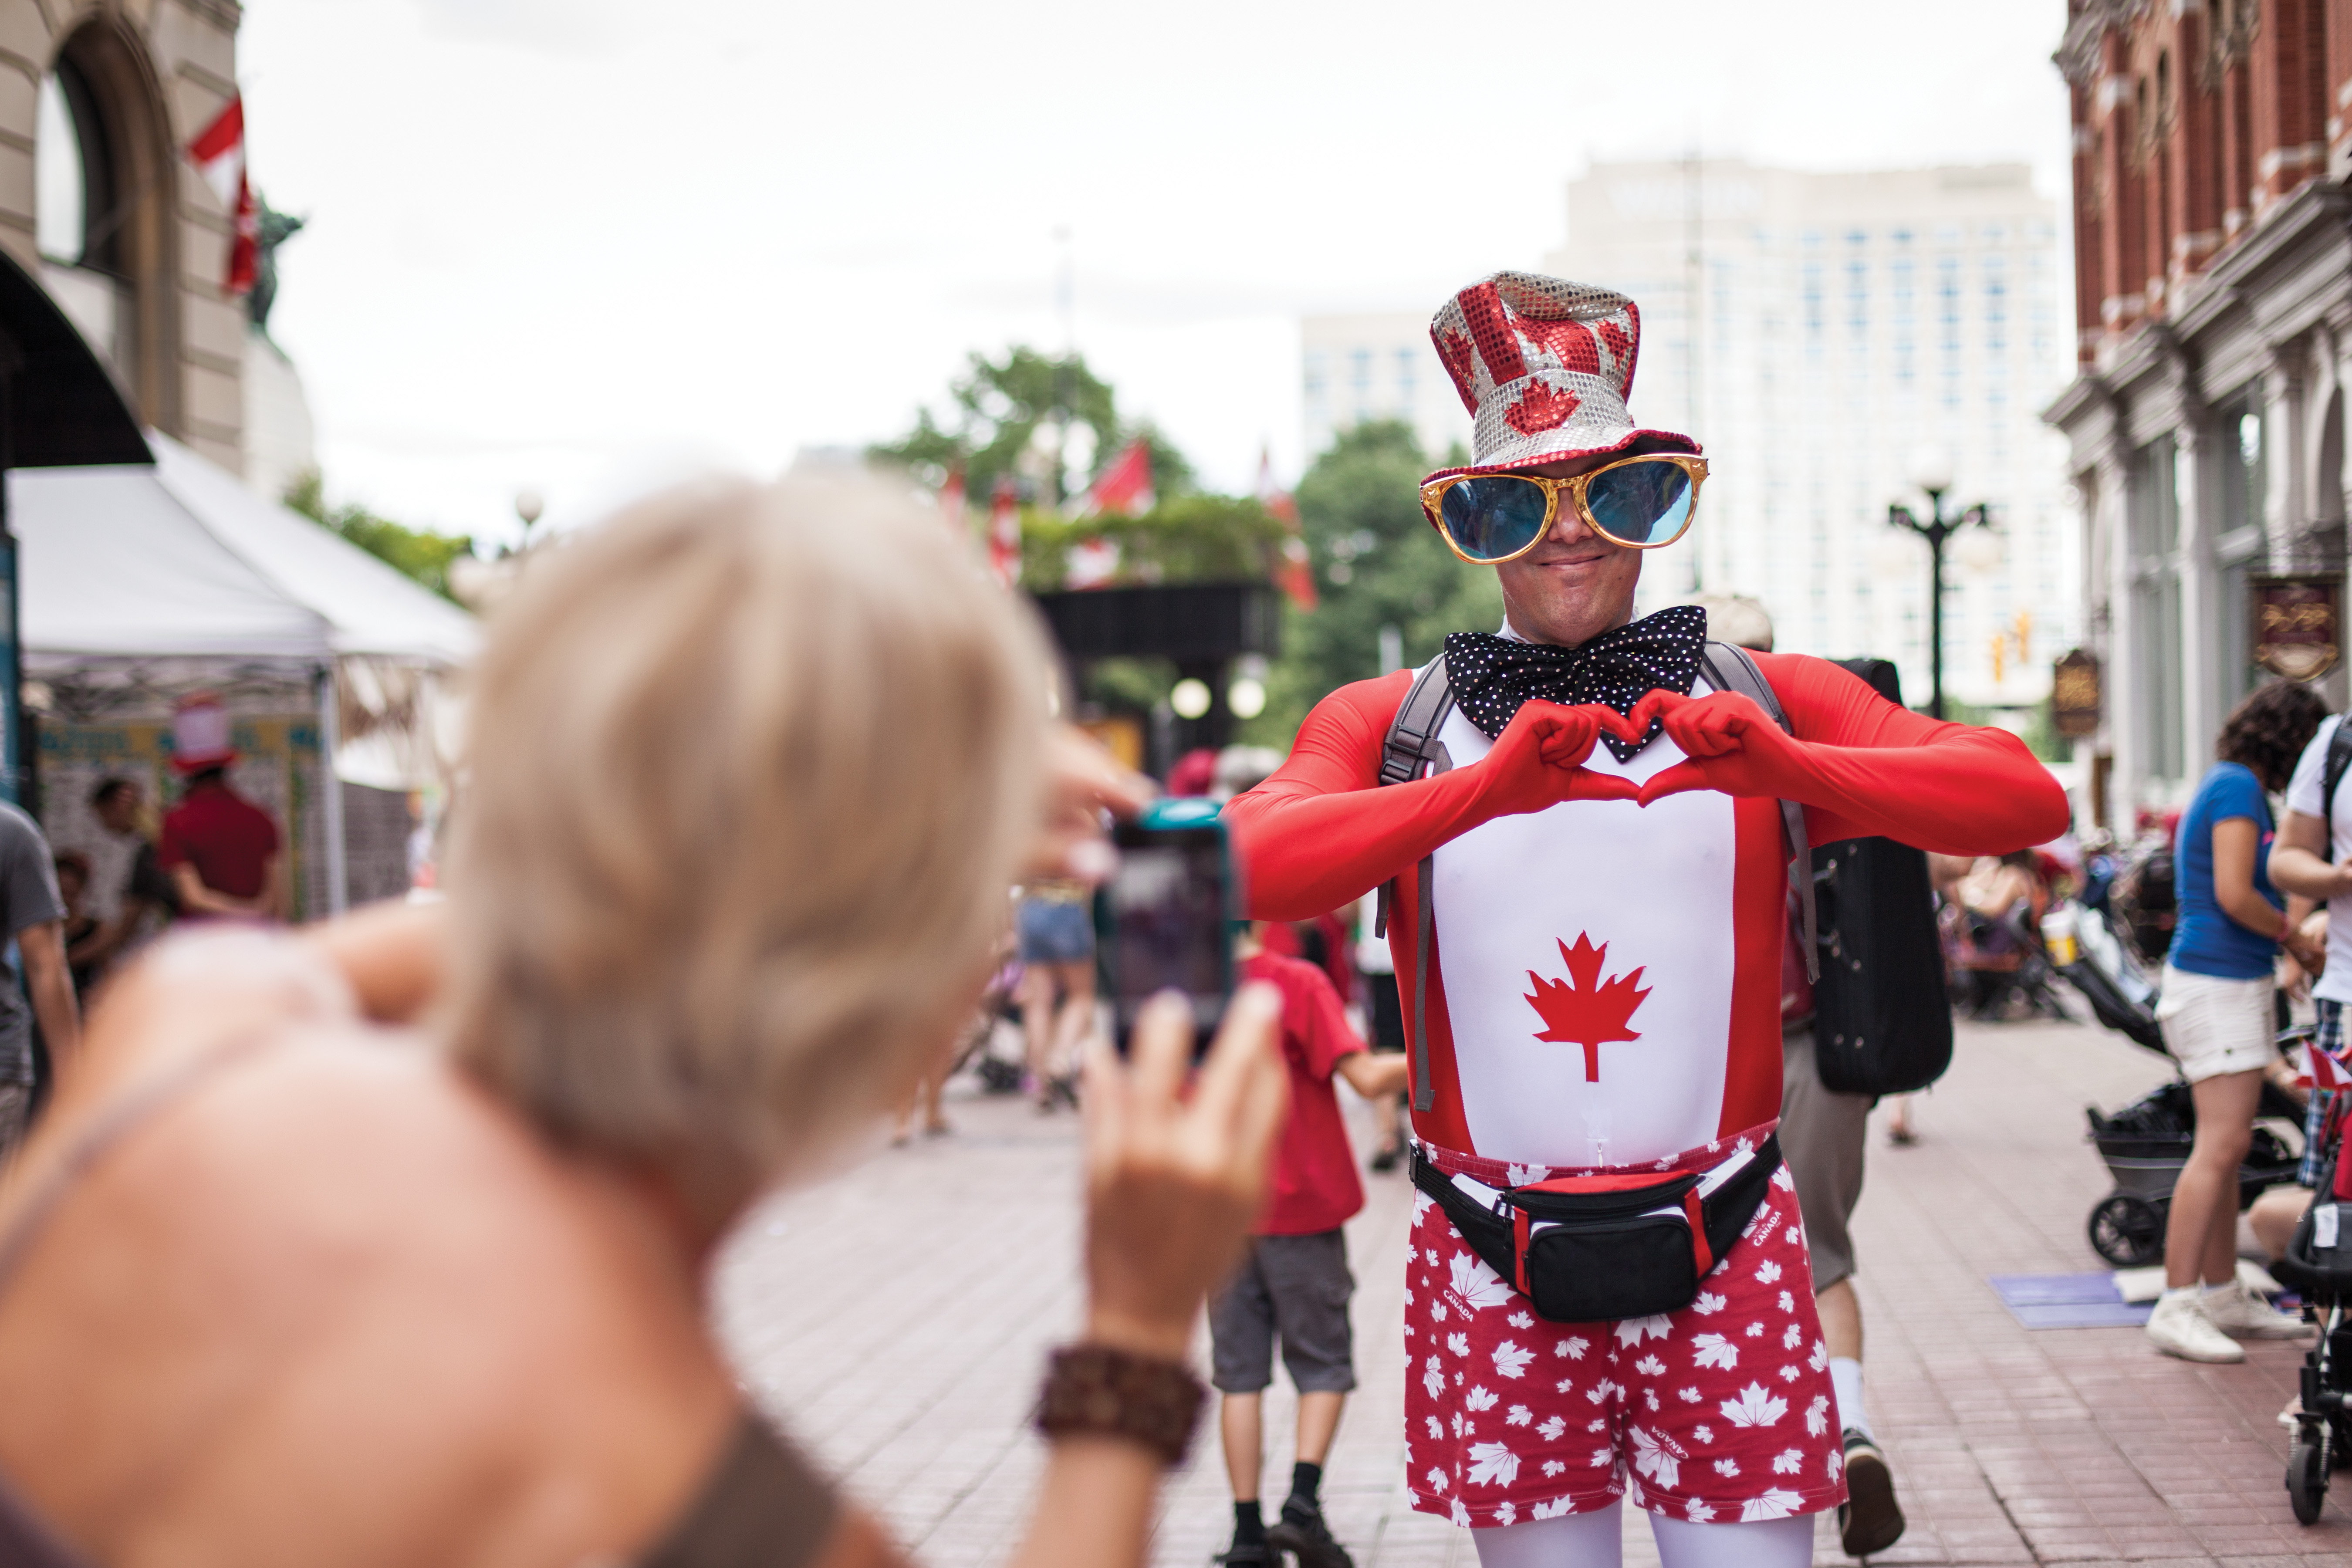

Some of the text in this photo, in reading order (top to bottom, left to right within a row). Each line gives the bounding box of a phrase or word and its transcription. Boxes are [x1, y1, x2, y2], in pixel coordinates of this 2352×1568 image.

[1754, 1211, 1781, 1246] CANADA
[1443, 1290, 1473, 1322] CANADA
[1652, 1426, 1689, 1459] CANADA
[1607, 1485, 1624, 1495] CANA
